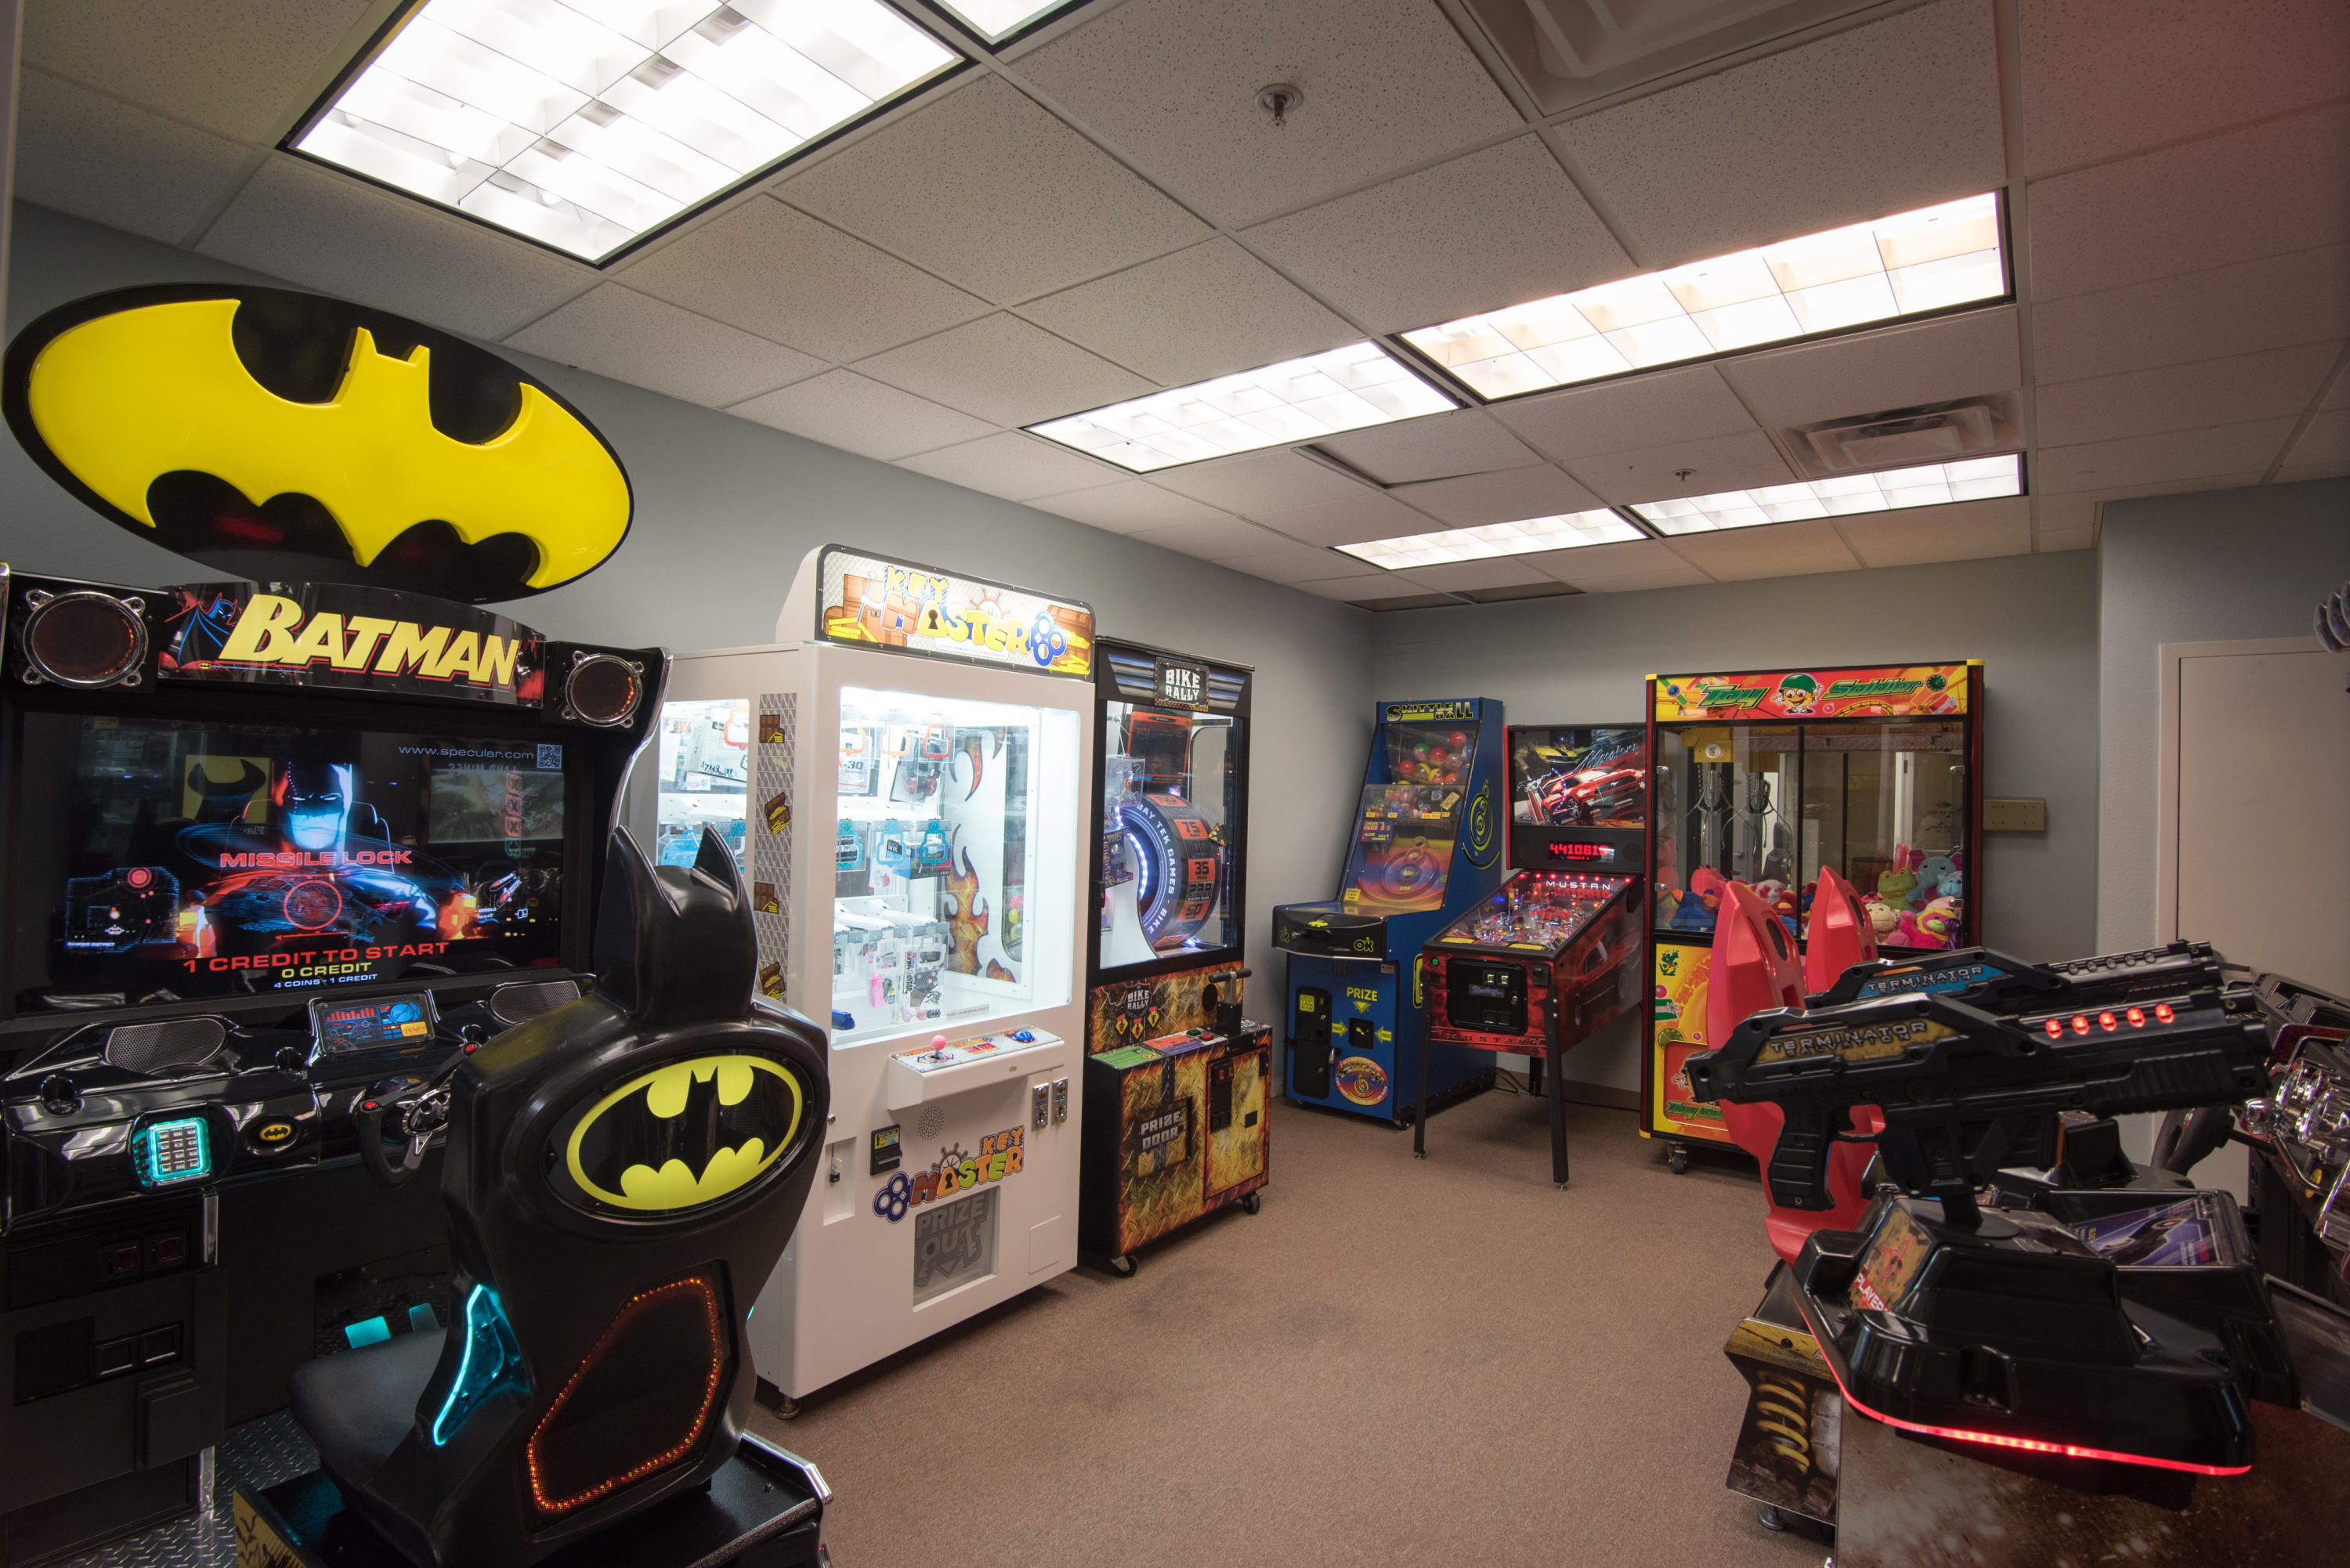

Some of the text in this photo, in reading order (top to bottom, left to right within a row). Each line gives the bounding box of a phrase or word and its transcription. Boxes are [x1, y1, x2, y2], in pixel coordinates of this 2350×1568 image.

[884, 565, 949, 602] KEY
[881, 590, 1029, 656] MASTER
[216, 594, 522, 688] BATMAN
[1165, 668, 1201, 688] BIKE
[1165, 685, 1200, 701] RALLY
[1696, 676, 1924, 710] Toy Soldier
[1386, 702, 1454, 722] SKITTLE
[1434, 701, 1473, 720] BALL
[398, 746, 534, 758] www.specular.com
[1136, 802, 1156, 819] BAY
[1156, 821, 1171, 845] TEK
[1180, 821, 1200, 833] 75
[219, 851, 413, 868] MISSILE LOCK
[1166, 848, 1177, 895] GAMES
[1194, 862, 1209, 875] 35
[1147, 908, 1168, 934] BIKE
[1185, 904, 1202, 916] 50
[183, 941, 450, 974] 1 CREDIT TO START
[281, 962, 372, 979] 0 CREDIT
[284, 978, 320, 988] COINS
[338, 974, 378, 983] CREDIT
[1867, 965, 1984, 991] TERMINATOR
[1347, 986, 1379, 1002] PRIZE
[1880, 974, 1972, 992] SALVATION
[1126, 999, 1149, 1010] RALLY
[1127, 989, 1150, 1002] BIKE
[1770, 1021, 1928, 1053] TERMINATOR
[1786, 1031, 1911, 1057] SALVATION
[1141, 1111, 1182, 1136] PRIZE
[981, 1125, 1024, 1155] KEY
[1141, 1125, 1179, 1151] DOOR
[909, 1145, 1023, 1206] MASTER
[917, 1193, 987, 1239] PRIZE
[922, 1222, 981, 1263] OUT
[1854, 1272, 1885, 1312] PLAYER
